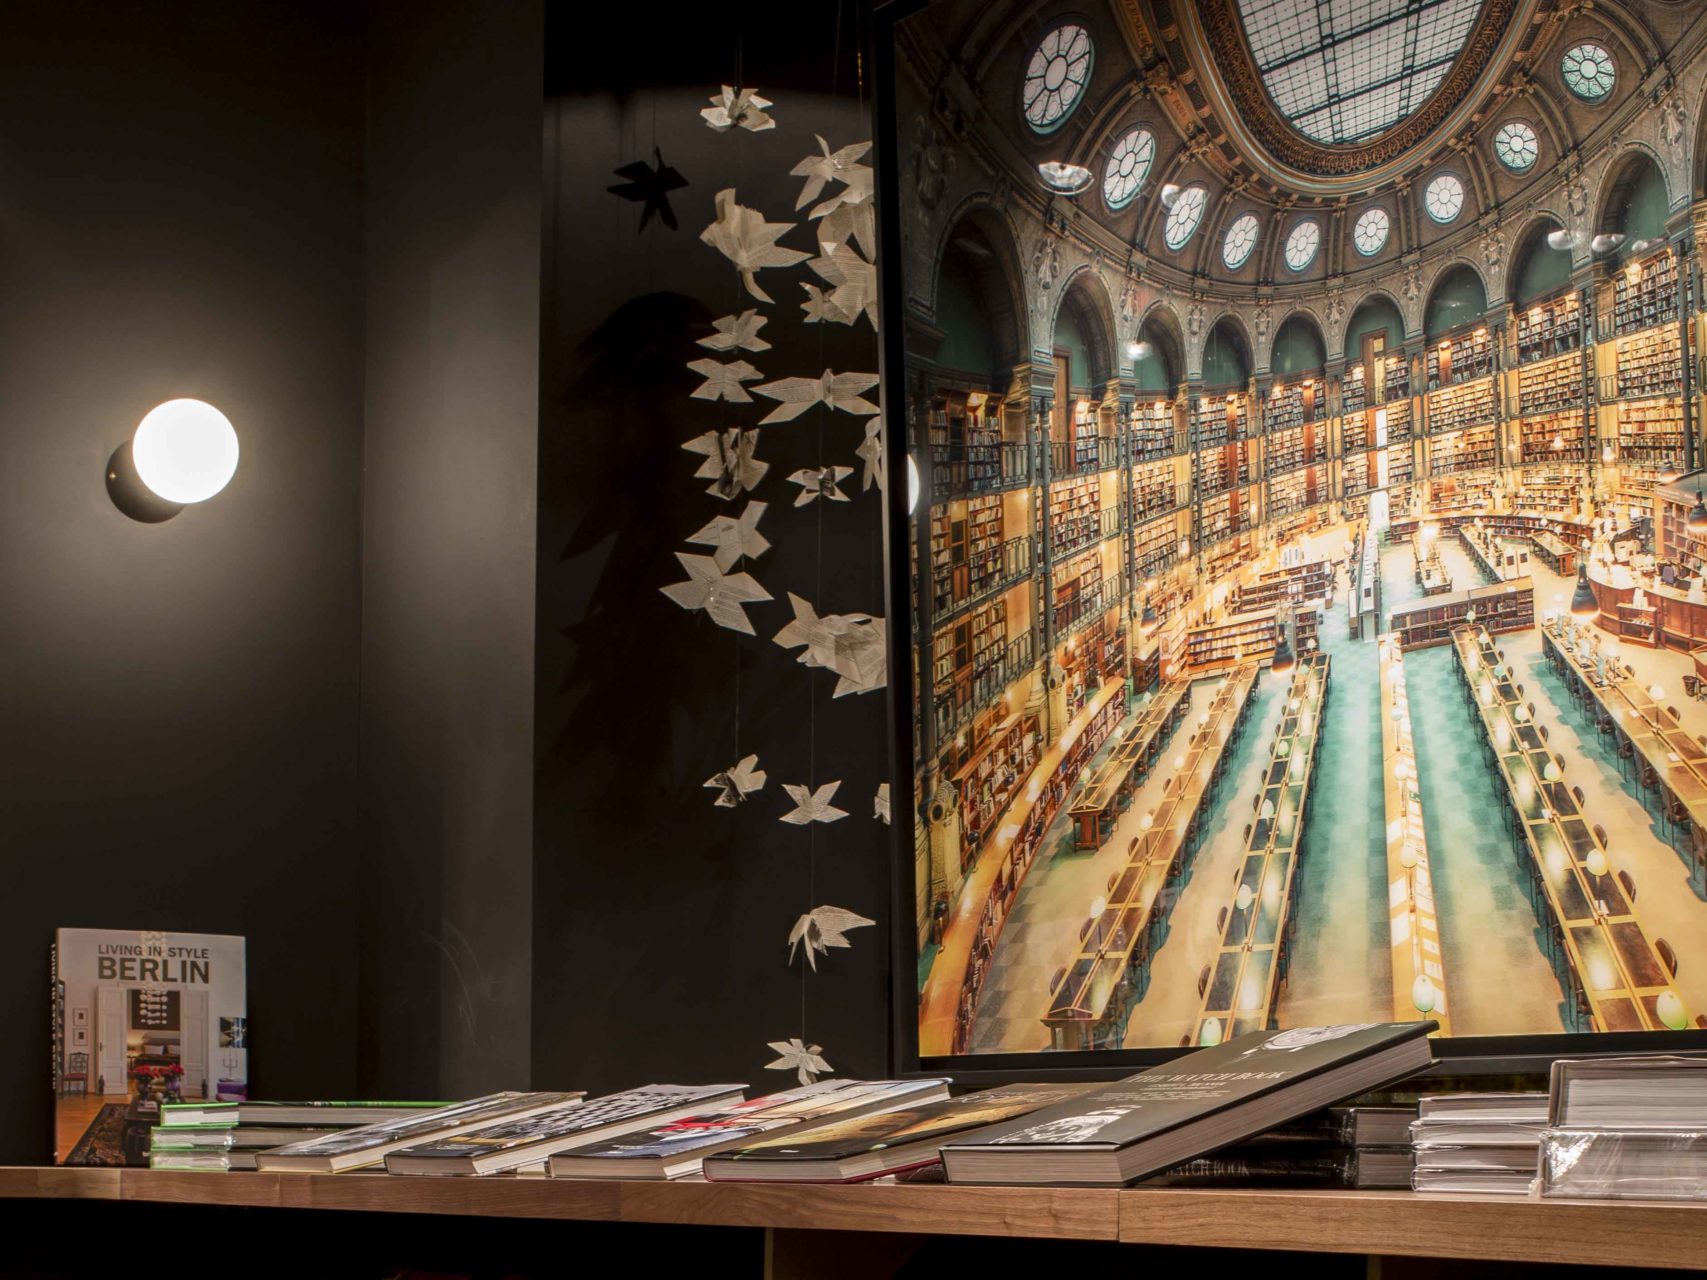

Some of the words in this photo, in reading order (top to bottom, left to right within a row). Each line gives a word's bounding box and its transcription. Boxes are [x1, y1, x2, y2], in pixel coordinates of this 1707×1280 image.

[98, 944, 142, 957] LIVING
[148, 945, 162, 957] IN
[168, 946, 209, 959] STYLE
[98, 957, 209, 984] BERLIN
[1213, 1159, 1250, 1177] BOOK
